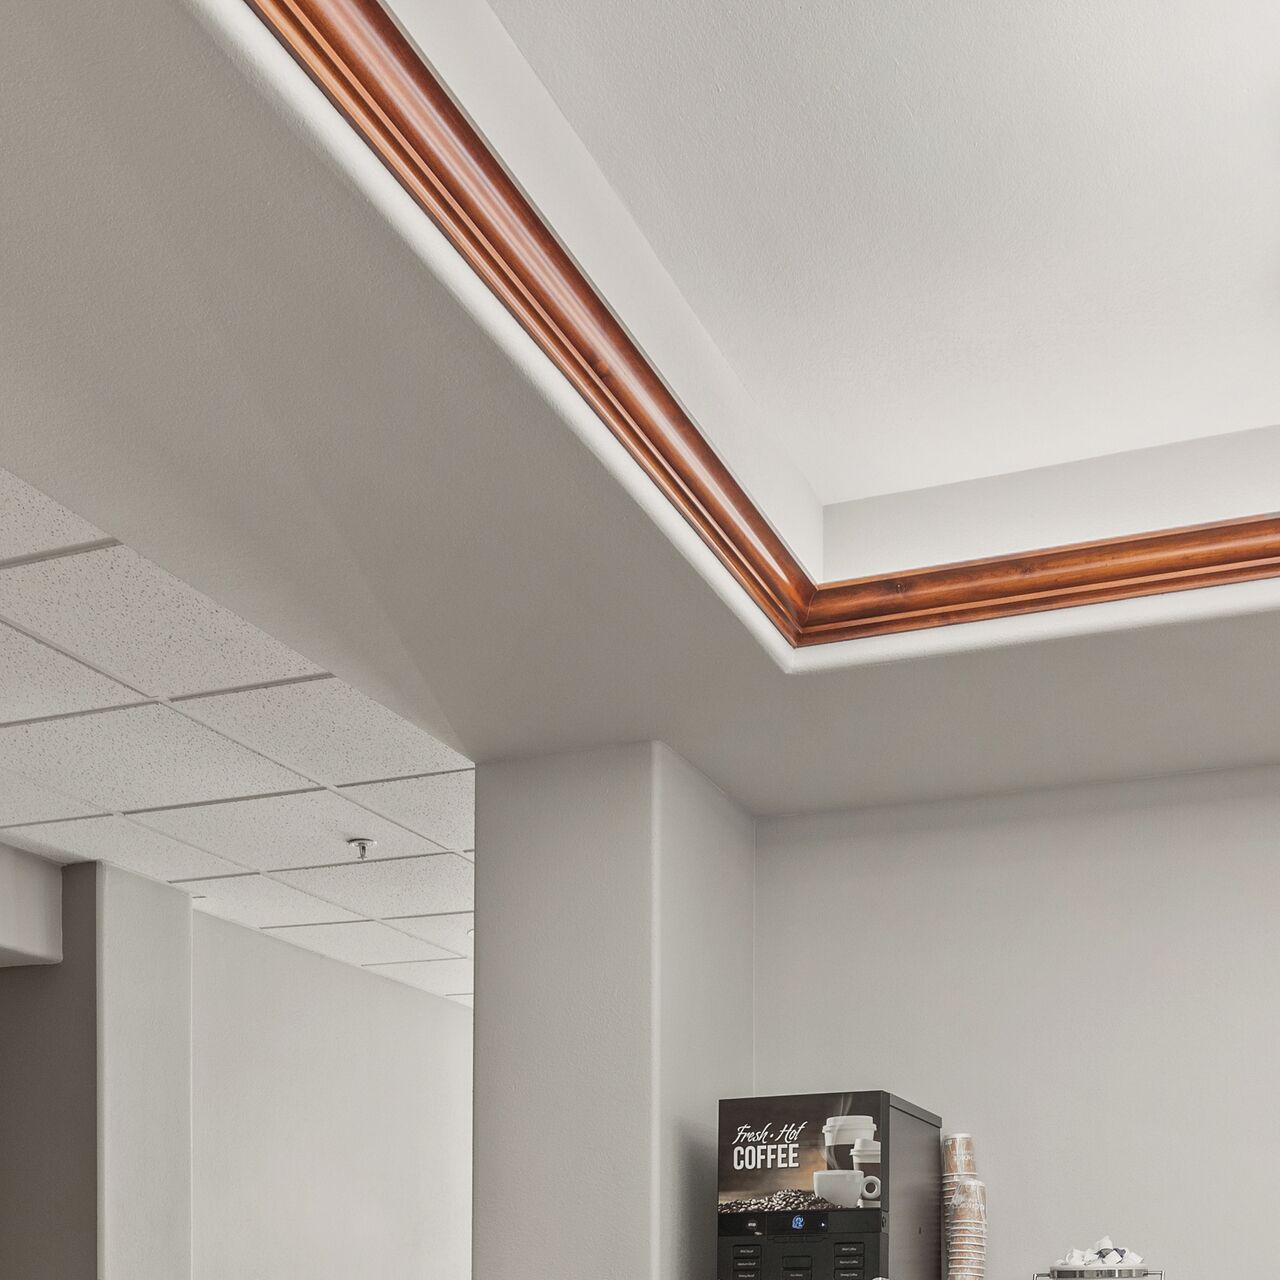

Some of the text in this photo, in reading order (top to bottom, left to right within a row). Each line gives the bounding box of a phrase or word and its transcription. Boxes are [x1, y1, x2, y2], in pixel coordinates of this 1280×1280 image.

[731, 1120, 808, 1144] Fresh Hot
[733, 1143, 799, 1170] COFFEE
